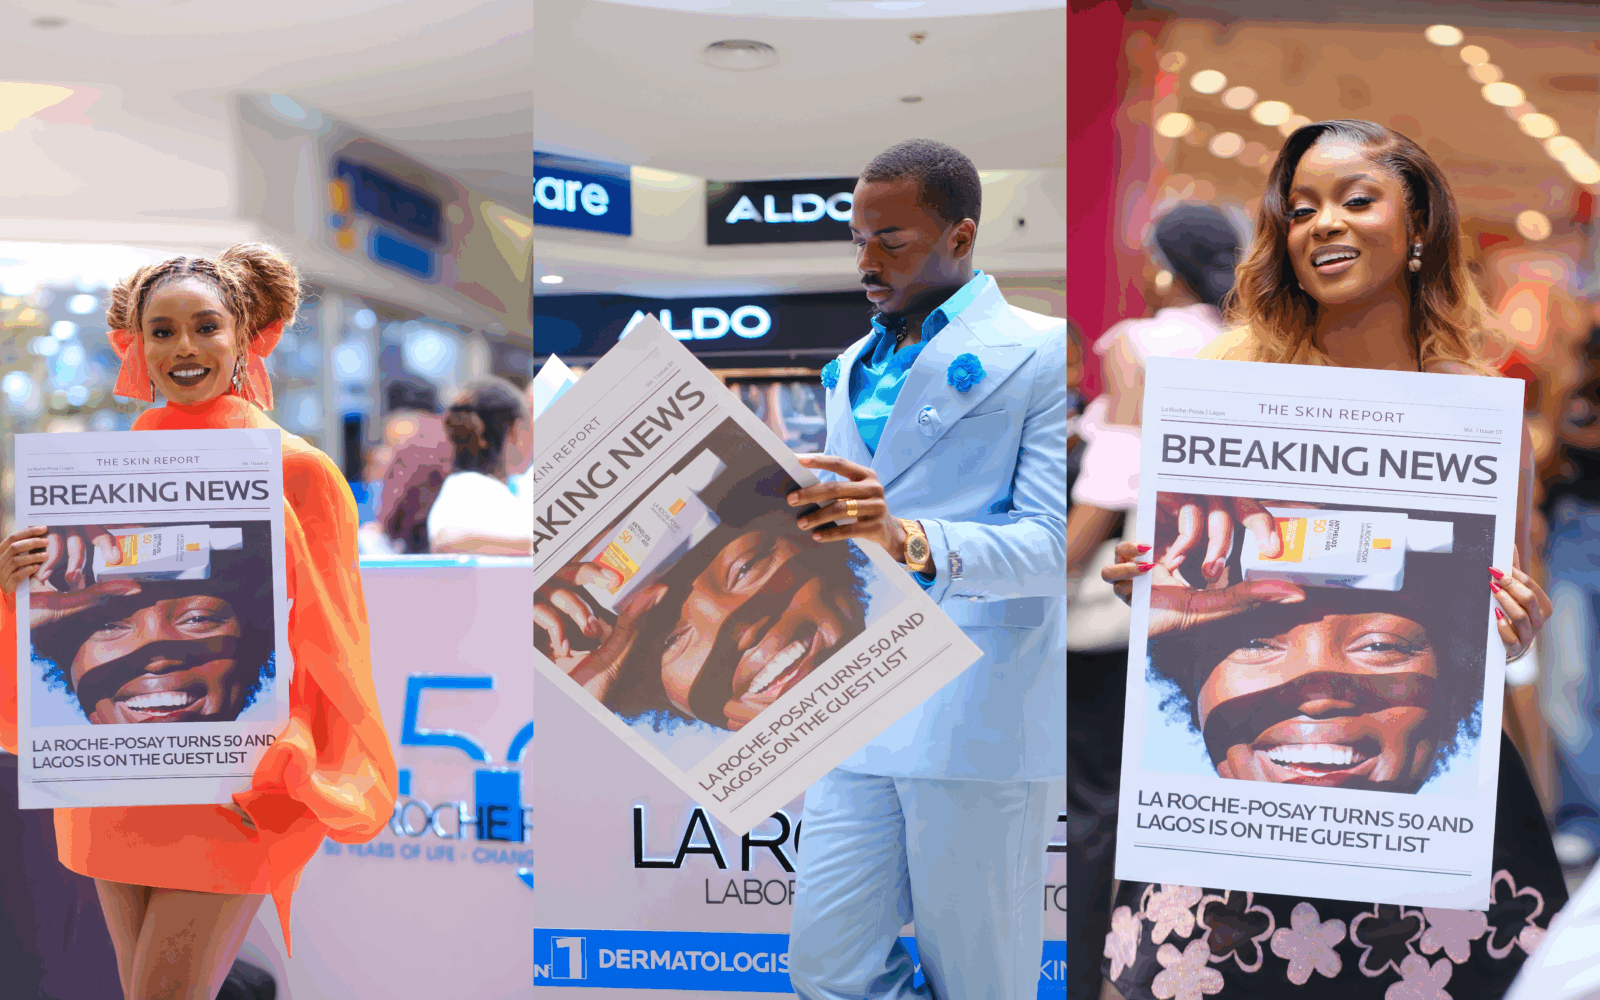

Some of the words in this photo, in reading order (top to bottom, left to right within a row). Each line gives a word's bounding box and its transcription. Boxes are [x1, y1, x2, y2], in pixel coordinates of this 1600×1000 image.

[533, 176, 610, 216] are
[725, 192, 853, 224] ALDO
[608, 380, 705, 470] NEWS
[1258, 403, 1289, 416] THE
[1295, 405, 1332, 419] SKIN
[1339, 408, 1405, 424] REPORT
[552, 416, 601, 463] REPORT
[96, 458, 119, 466] THE
[123, 457, 150, 466] SKIN
[154, 456, 200, 465] REPORT
[1161, 433, 1369, 477] BREAKING
[1379, 448, 1498, 485] NEWS
[30, 481, 178, 506] BREAKING
[185, 480, 269, 502] NEWS
[631, 521, 652, 542] ANTHELIOS
[1331, 520, 1341, 548] ANTHELIOS
[698, 771, 723, 791] LA
[717, 692, 818, 778] ROCHE-POSAY
[814, 653, 872, 699] TURNS
[868, 637, 892, 660] 50
[889, 612, 925, 643] AND
[712, 758, 763, 803] LAGOS
[761, 750, 777, 768] IS
[774, 732, 800, 755] ON
[794, 710, 830, 741] THE
[826, 674, 877, 714] GUEST
[873, 646, 909, 678] LIST
[32, 739, 52, 752] LA
[54, 736, 165, 752] ROCHE-POSAY
[166, 735, 222, 748] TURNS
[224, 735, 243, 747] 50
[244, 734, 277, 747] AND
[32, 755, 84, 769] LAGOS
[87, 755, 102, 767] IS
[103, 754, 127, 767] ON
[129, 753, 161, 766] THE
[162, 752, 214, 765] GUEST
[216, 751, 248, 764] LIST
[1138, 789, 1164, 808] LA
[1166, 791, 1318, 822] ROCHE-POSAY
[1318, 805, 1394, 828] TURNS
[1398, 812, 1424, 831] 50
[1427, 814, 1474, 834] AND
[633, 807, 727, 870] LA
[741, 810, 802, 873] R
[1136, 812, 1206, 835] LAGOS
[1209, 818, 1229, 836] IS
[1231, 821, 1263, 839] ON
[1266, 824, 1308, 844] THE
[1311, 827, 1383, 851] GUEST
[1385, 834, 1431, 854] LIST
[599, 948, 790, 974] DERMATOLOGIS
